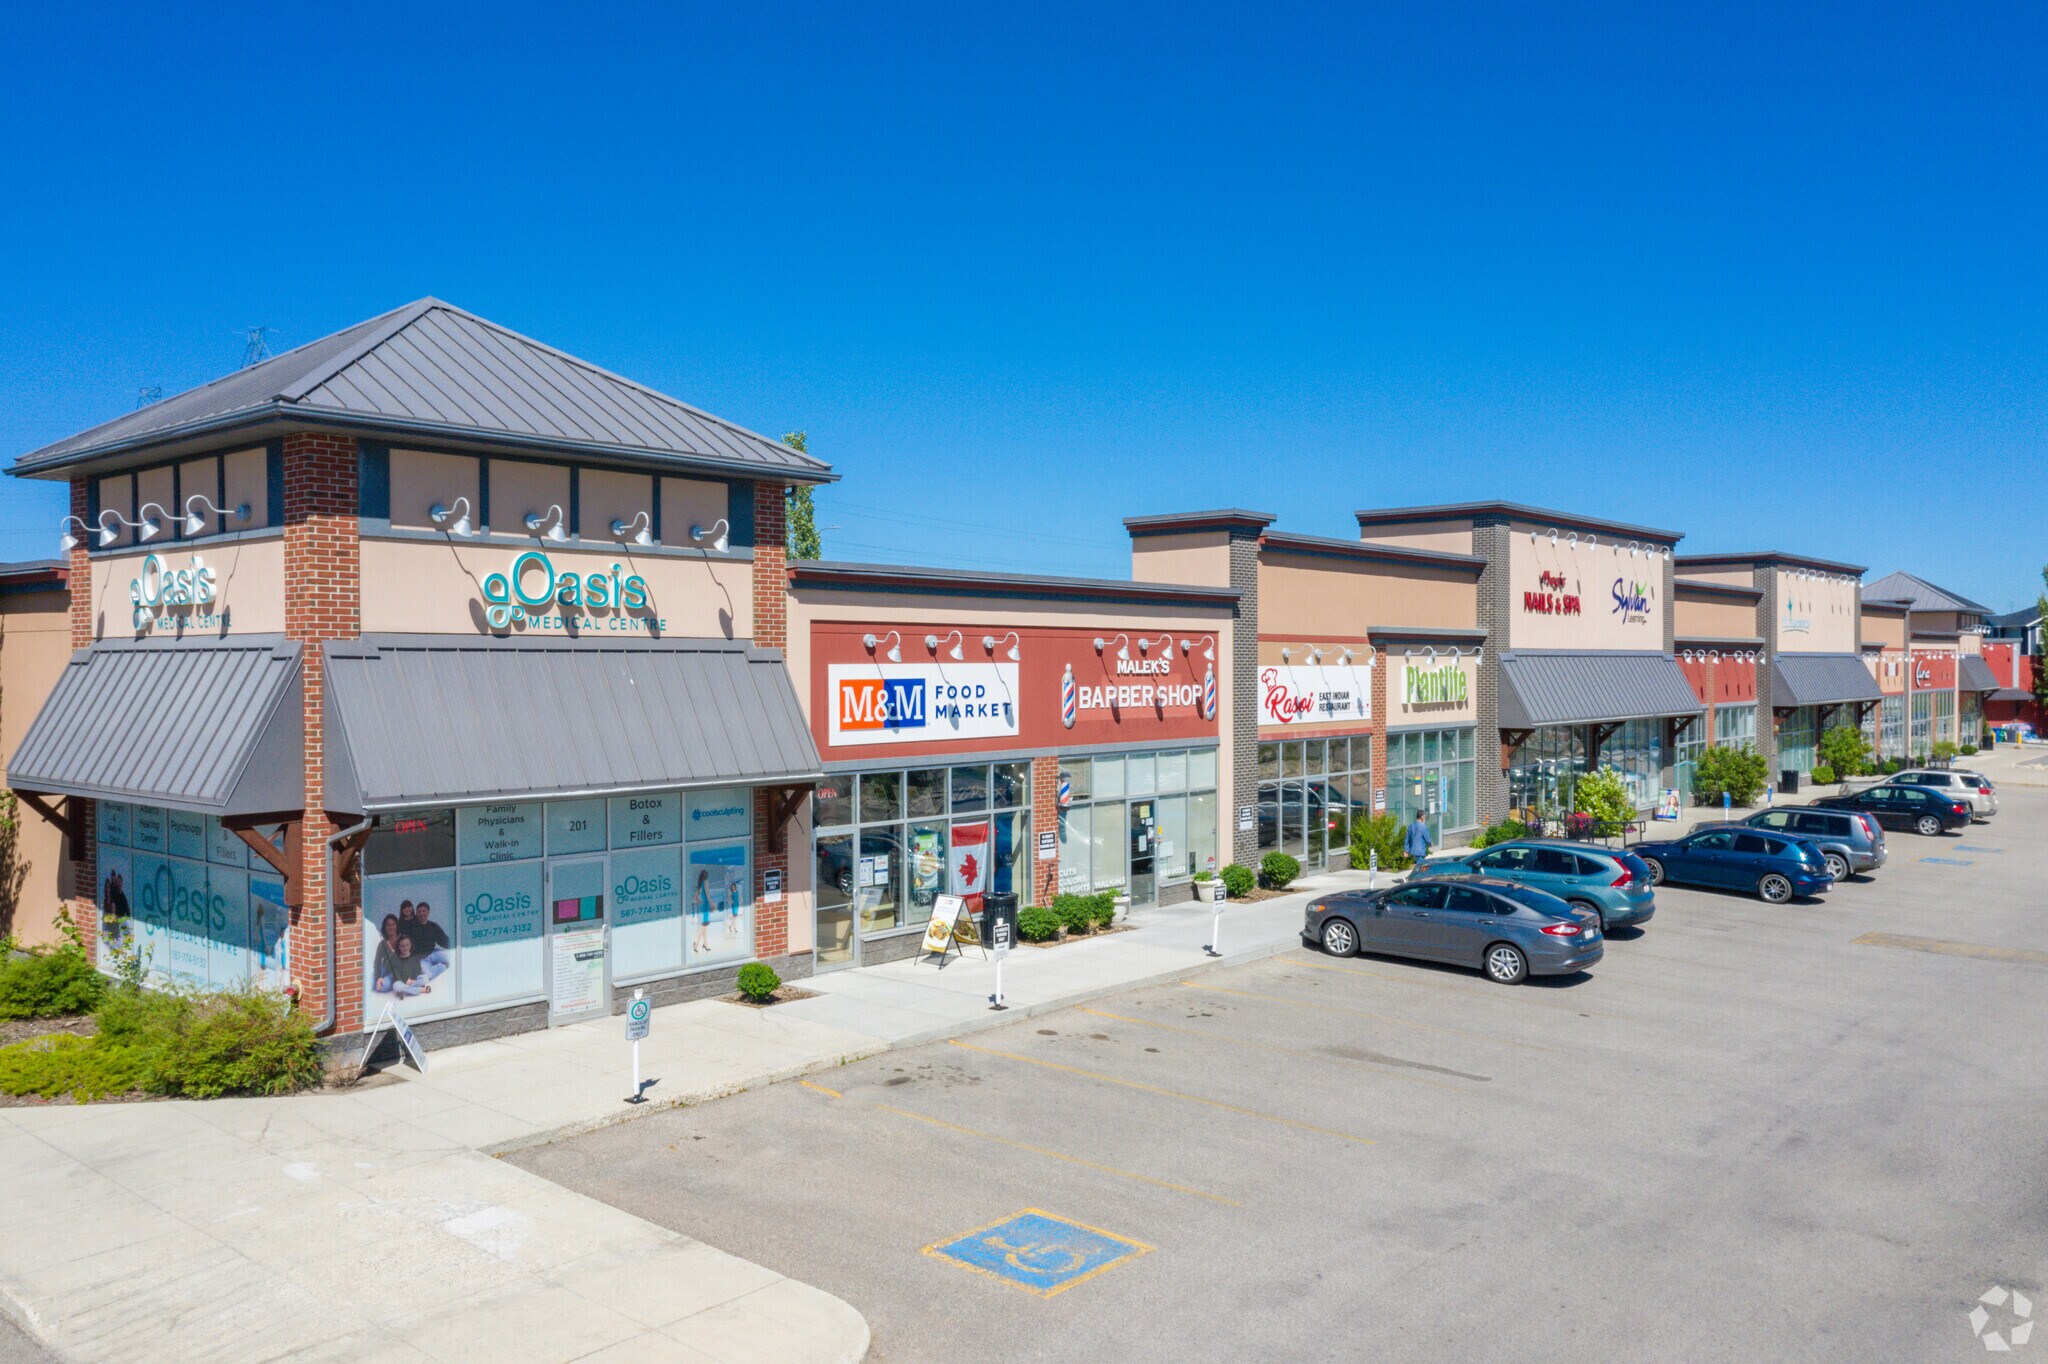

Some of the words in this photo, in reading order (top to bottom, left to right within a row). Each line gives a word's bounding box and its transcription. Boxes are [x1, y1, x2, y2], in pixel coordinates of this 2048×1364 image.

[142, 553, 216, 607] Oasis
[511, 551, 647, 609] Oasis
[1524, 591, 1554, 613] NAILS
[1555, 597, 1562, 613] &
[1563, 594, 1581, 614] SPA
[1612, 577, 1651, 625] Sylvan
[157, 615, 195, 631] MEDICAL
[198, 613, 232, 629] CENTRE
[528, 616, 601, 631] MEDICAL
[609, 617, 667, 631] CENTRE
[1117, 657, 1170, 675] MALEK'S
[936, 684, 986, 699] FOOD
[1403, 665, 1468, 706] Plantlife
[842, 684, 924, 722] M&M
[1318, 691, 1332, 701] EAST
[1332, 691, 1350, 700] INDIAN
[936, 702, 1011, 719] MARKET
[1265, 685, 1314, 723] Rasoi
[1318, 702, 1351, 712] RESTAURANT
[817, 787, 837, 800] OPEN
[486, 804, 517, 815] Family
[629, 799, 663, 811] Botox
[701, 806, 745, 818] coolsculpting
[395, 819, 427, 834] OPEN
[478, 815, 525, 828] Physicians
[569, 819, 588, 832] 201
[642, 814, 650, 825] &
[498, 827, 506, 838] &
[630, 830, 663, 843] Fillers
[484, 838, 520, 850] Walk-in
[489, 851, 515, 863] Clinic
[624, 874, 672, 895] Oasis
[155, 864, 226, 931] Oasis
[476, 892, 531, 914] Oasis
[620, 903, 673, 918] 587-774-3132
[471, 922, 532, 939] 587-774-3132
